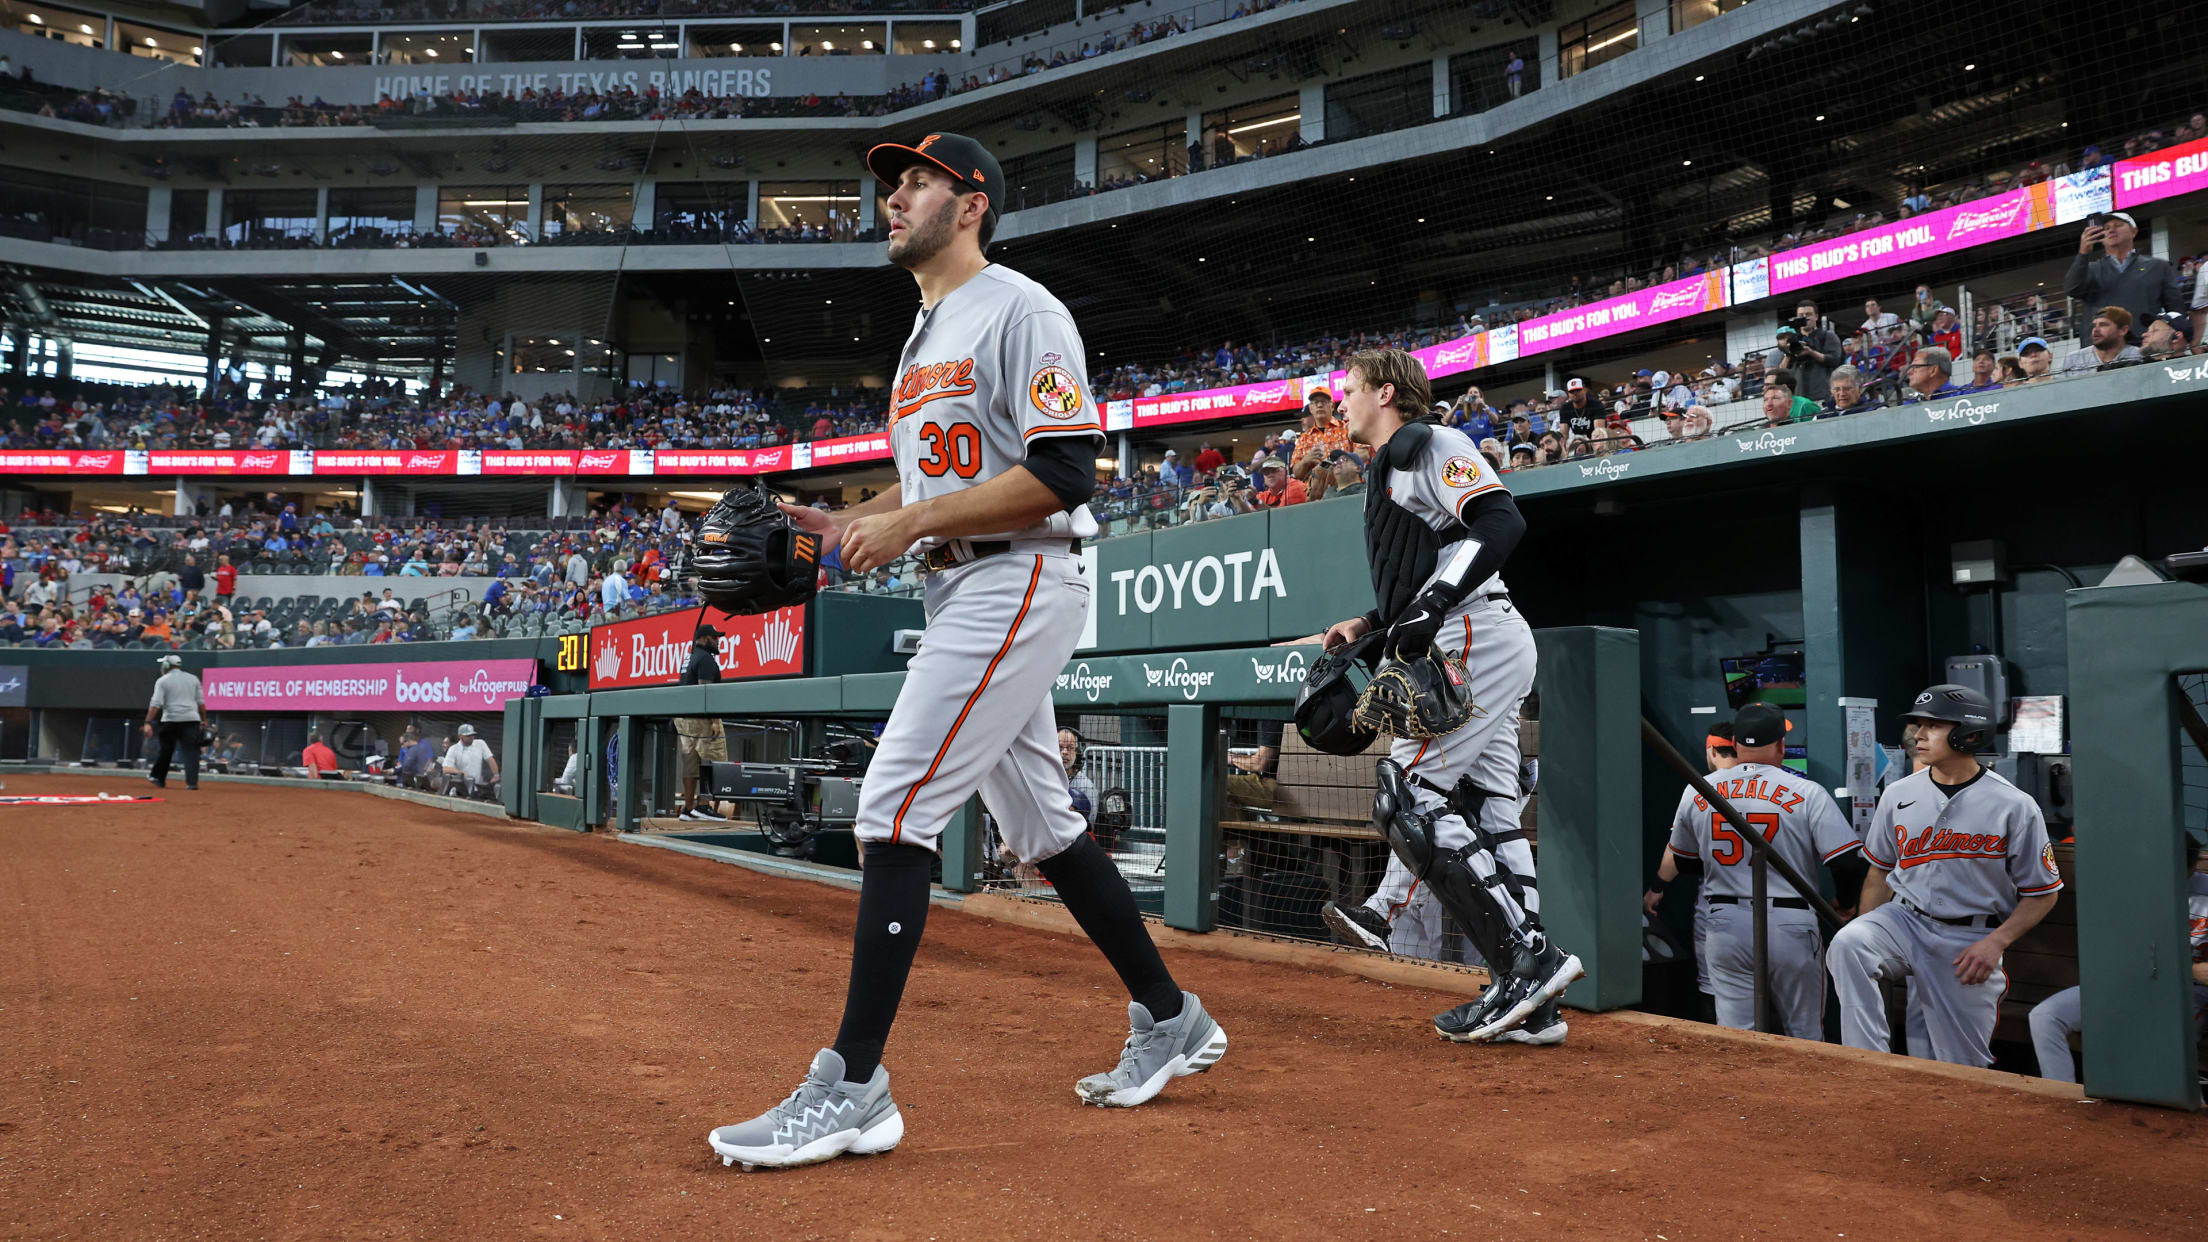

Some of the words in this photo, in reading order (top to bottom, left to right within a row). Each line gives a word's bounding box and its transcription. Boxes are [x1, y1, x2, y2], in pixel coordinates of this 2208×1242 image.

[374, 75, 449, 103] HOME
[459, 74, 492, 99] OF
[500, 73, 548, 101] THE
[557, 71, 639, 98] TEXAS
[650, 68, 772, 98] RANGERS
[2120, 161, 2172, 192] THIS
[1775, 256, 1809, 280] THIS
[1811, 245, 1859, 270] BUD'S
[1861, 235, 1893, 258] FOR
[1895, 225, 1935, 249] YOU.
[1523, 327, 1548, 344] THIS
[1550, 316, 1585, 338] BUD'S
[1587, 309, 1610, 328] FOR
[1612, 301, 1640, 322] YOU.
[1334, 377, 1347, 392] TH
[1042, 407, 1078, 418] ORIOLES
[1137, 403, 1159, 417] THIS
[1160, 399, 1190, 415] BUD'S
[1191, 396, 1211, 411] FOR
[1213, 394, 1236, 408] YOU.
[1949, 399, 1999, 425] Kroger
[919, 421, 982, 479] 30
[1755, 432, 1797, 455] Kroger
[658, 456, 678, 466] THIS
[680, 456, 707, 467] BUD'S
[708, 456, 726, 466] FOR
[728, 456, 748, 466] YOU.
[1595, 459, 1630, 480] Kroger
[1111, 548, 1287, 615] TOYOTA
[630, 630, 741, 679] Budweer
[1277, 651, 1307, 683] Kro
[207, 682, 216, 697] A
[218, 682, 246, 697] NEW
[247, 681, 283, 697] LEVEL
[285, 680, 303, 696] OF
[305, 679, 388, 697] MEMBERSHIP
[460, 684, 468, 694] by
[1071, 662, 1113, 702] Kroger
[1165, 658, 1214, 700] Kroger
[1694, 774, 1805, 814] GNZÁLEZ
[1711, 812, 1779, 866] 57
